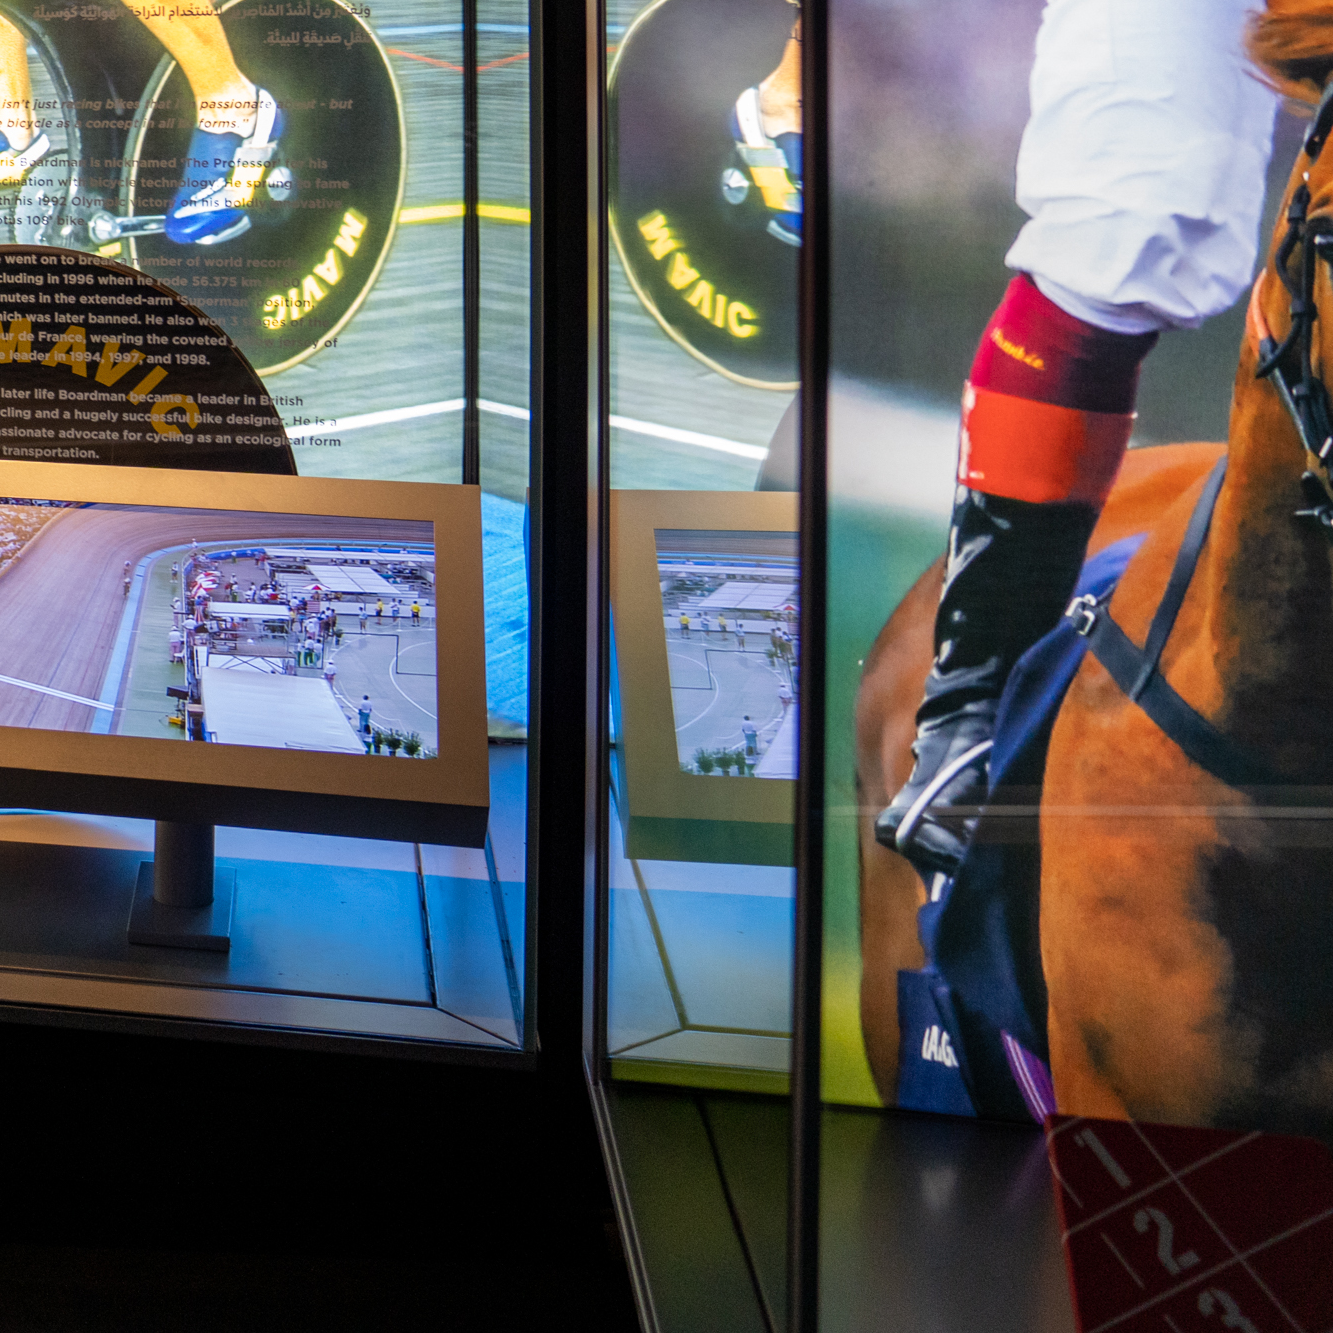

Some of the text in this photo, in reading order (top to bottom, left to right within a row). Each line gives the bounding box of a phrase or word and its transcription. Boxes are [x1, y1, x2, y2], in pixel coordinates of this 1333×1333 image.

[262, 207, 368, 330] MAVIC
[47, 273, 59, 284] in
[63, 274, 94, 284] 1996
[97, 274, 133, 285] when
[137, 275, 153, 285] he
[157, 277, 188, 286] rode
[192, 276, 237, 287] 56.375
[39, 292, 51, 303] in
[54, 293, 76, 304] the
[79, 294, 173, 306] extended-arm
[18, 330, 34, 341] de
[38, 331, 86, 344] France,
[90, 332, 143, 346] wearing
[147, 334, 169, 345] the
[172, 335, 227, 346] coveted
[10, 350, 50, 361] leader
[54, 350, 66, 361] in
[70, 351, 104, 364] 1994,
[109, 352, 143, 364] 1997,
[146, 353, 171, 364] and
[176, 353, 210, 365] 1998.
[1, 387, 31, 399] later
[34, 388, 55, 400] life
[58, 389, 126, 402] Boardman
[130, 391, 183, 404] became
[197, 393, 240, 405] leader
[244, 394, 256, 406] in
[260, 395, 304, 406] British
[58, 428, 119, 440] advocate
[123, 429, 142, 441] for
[235, 434, 305, 448] ecological
[309, 435, 341, 447] form
[2, 446, 100, 459] transportation.
[1074, 1127, 1132, 1190] 1
[1134, 1207, 1201, 1276] 2
